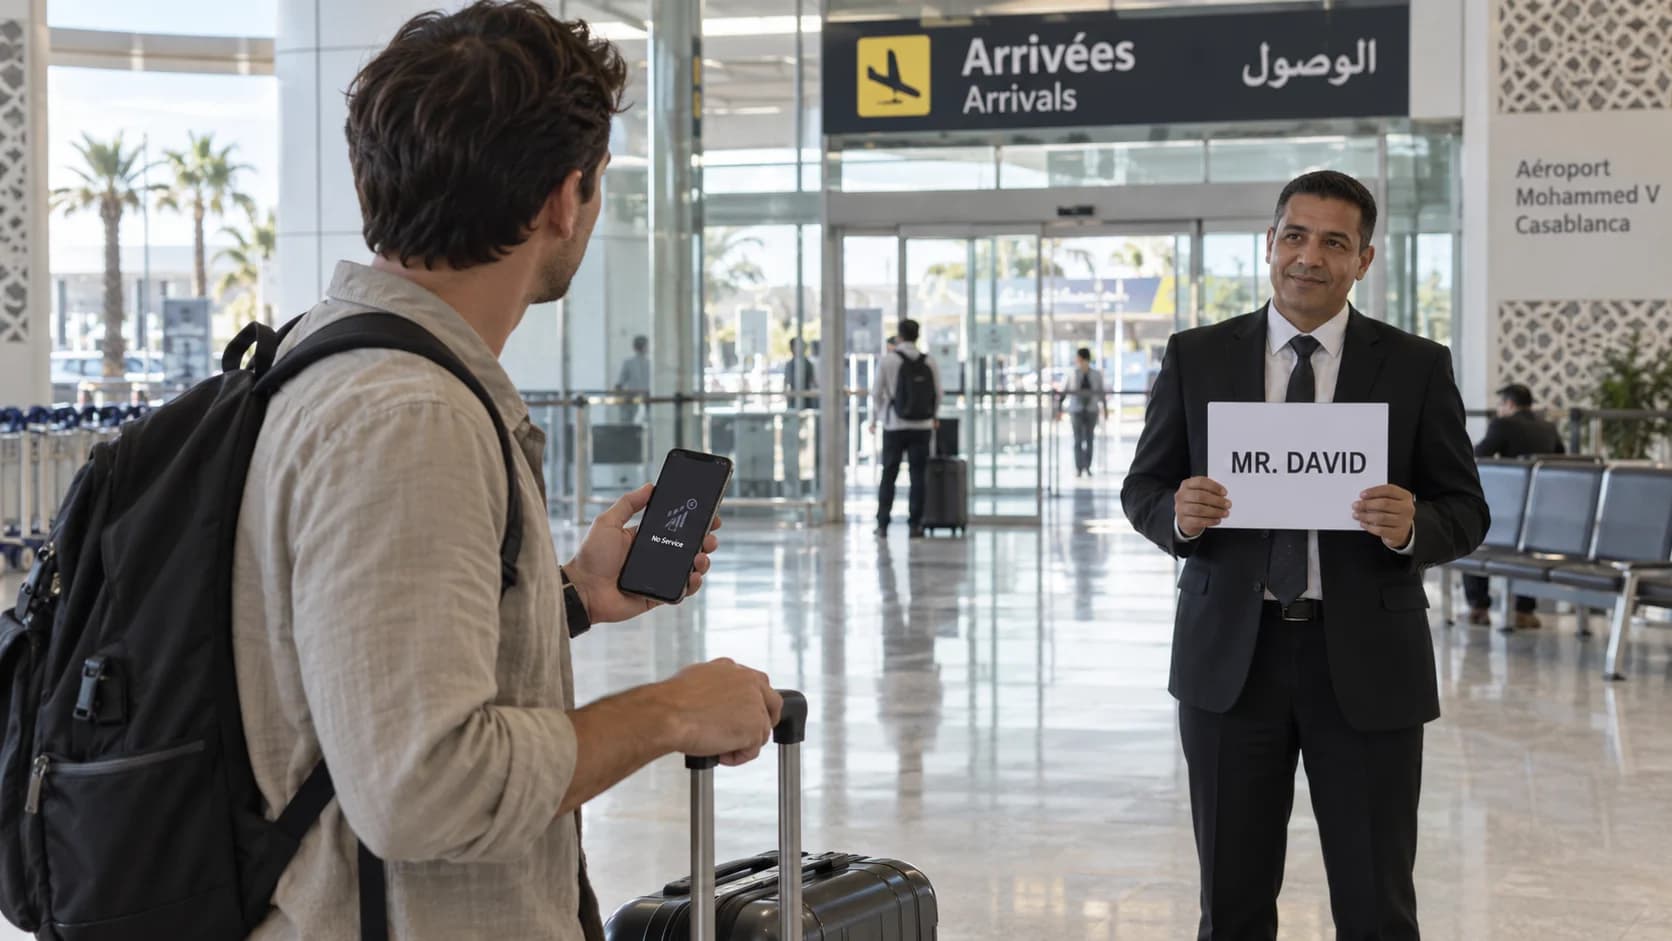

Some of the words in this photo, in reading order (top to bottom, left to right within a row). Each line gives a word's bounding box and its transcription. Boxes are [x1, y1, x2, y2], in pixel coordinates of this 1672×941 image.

[962, 32, 1136, 77] Arrivées
[1242, 39, 1377, 89] الوصول
[963, 81, 1078, 115] Arrivals
[1516, 158, 1611, 182] Aéroport
[1516, 184, 1639, 207] Mohammed
[1645, 184, 1661, 204] V
[1515, 213, 1631, 235] Casablanca
[1231, 451, 1278, 474] MR.
[1287, 451, 1367, 474] DAVID
[651, 535, 661, 543] No
[661, 536, 684, 548] Service
